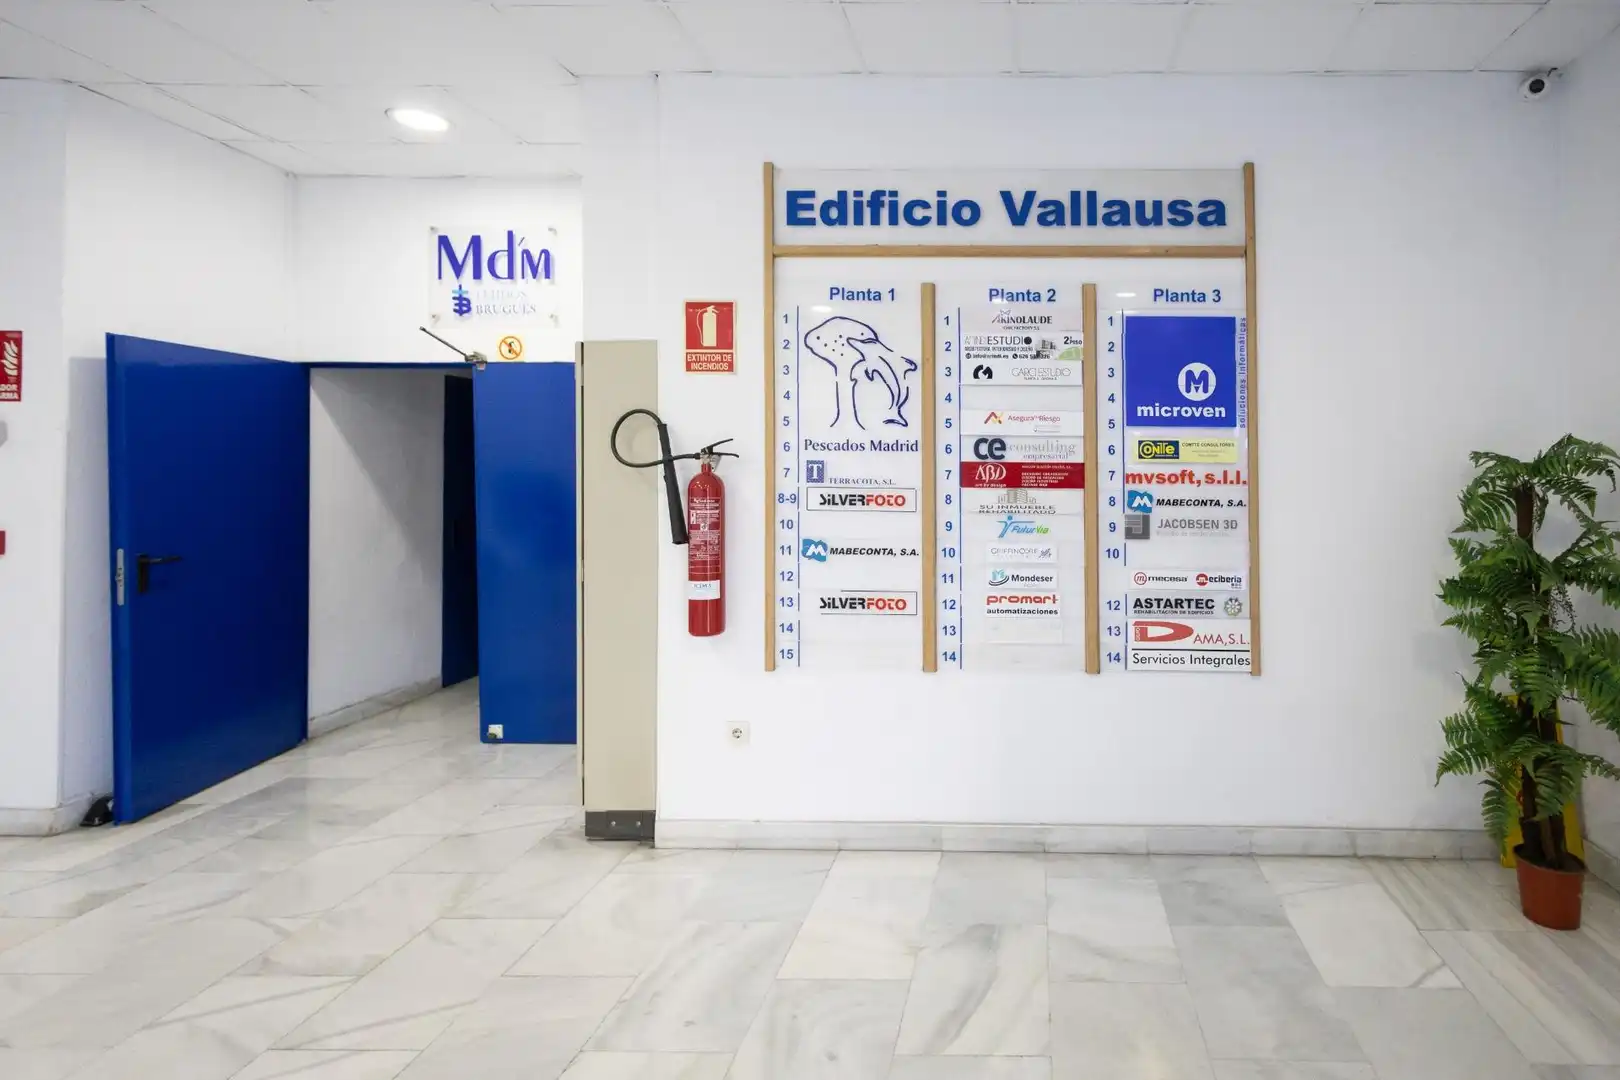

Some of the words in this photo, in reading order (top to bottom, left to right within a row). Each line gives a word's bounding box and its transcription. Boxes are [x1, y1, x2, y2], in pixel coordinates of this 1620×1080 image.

[786, 190, 981, 227] Edificio
[999, 190, 1227, 227] Vallausa
[829, 287, 881, 301] Planta
[888, 288, 895, 301] 1
[989, 288, 1041, 302] Planta
[1047, 289, 1056, 302] 2
[1153, 288, 1206, 302] Planta
[1212, 289, 1221, 302] 3
[783, 314, 788, 324] 1
[944, 315, 949, 325] 1
[1108, 316, 1113, 326] 1
[783, 340, 790, 349] 2
[945, 341, 951, 351] 2
[1108, 342, 1114, 351] 2
[687, 354, 721, 362] EXTINTOR
[723, 354, 732, 362] DE
[690, 362, 728, 371] INCENDIOS
[783, 365, 790, 375] 3
[945, 367, 951, 377] 3
[1108, 368, 1114, 377] 3
[783, 390, 790, 401] 4
[945, 393, 952, 403] 4
[1108, 393, 1115, 403] 4
[1238, 380, 1246, 428] soluciones
[1137, 403, 1225, 417] microven
[783, 416, 790, 426] 5
[945, 419, 952, 429] 5
[1108, 419, 1115, 429] 5
[783, 442, 790, 451] 6
[804, 439, 865, 451] Pescados
[870, 439, 918, 452] Madrid
[945, 444, 952, 454] 6
[974, 437, 1006, 460] ce
[1009, 440, 1076, 454] consulting
[1108, 445, 1115, 454] 6
[783, 468, 790, 477] 7
[945, 470, 952, 479] 7
[1108, 471, 1115, 480] 7
[1205, 470, 1247, 484] s.l.l.
[778, 493, 796, 503] 8-9
[945, 495, 952, 504] 8
[1109, 496, 1116, 507] 8
[1156, 499, 1224, 508] MABECONTA,
[1227, 499, 1247, 507] S.A.
[780, 519, 794, 529] 10
[945, 521, 952, 531] 9
[1109, 522, 1116, 532] 9
[1157, 519, 1219, 529] JACOBSEN
[1223, 519, 1238, 530] 3D
[780, 545, 792, 555] 11
[829, 547, 897, 556] MABECONTA,
[900, 548, 919, 556] S.A.
[942, 548, 955, 558] 10
[1105, 548, 1120, 559] 10
[780, 571, 794, 581] 12
[942, 574, 954, 584] 11
[1011, 574, 1053, 582] Mondeser
[780, 597, 794, 608] 13
[942, 600, 956, 610] 12
[1107, 600, 1121, 611] 12
[1133, 598, 1215, 609] ASTARTEC
[779, 623, 794, 633] 14
[942, 626, 956, 636] 13
[1107, 626, 1121, 636] 13
[779, 649, 794, 659] 15
[942, 652, 956, 661] 14
[1107, 653, 1121, 663] 14
[1133, 653, 1185, 665] Servicios
[1190, 654, 1251, 668] Integrales
